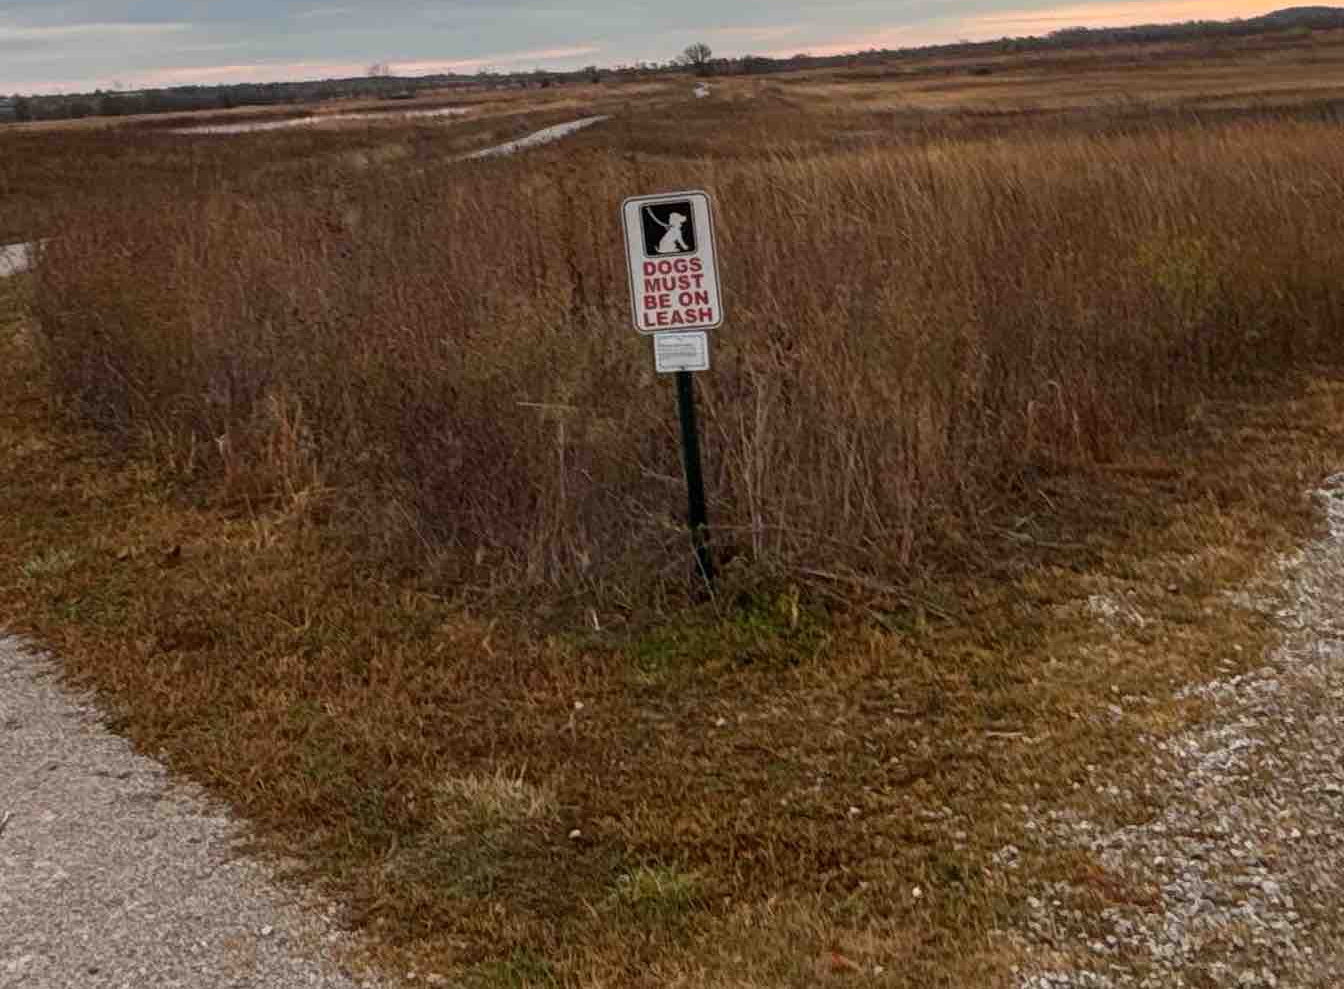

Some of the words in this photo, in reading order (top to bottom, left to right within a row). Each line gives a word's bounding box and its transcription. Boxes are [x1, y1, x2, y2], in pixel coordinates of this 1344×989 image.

[643, 258, 702, 275] DOGS
[644, 274, 703, 292] MUST
[644, 293, 673, 309] BE
[679, 291, 709, 306] ON
[644, 308, 713, 326] LEASH
